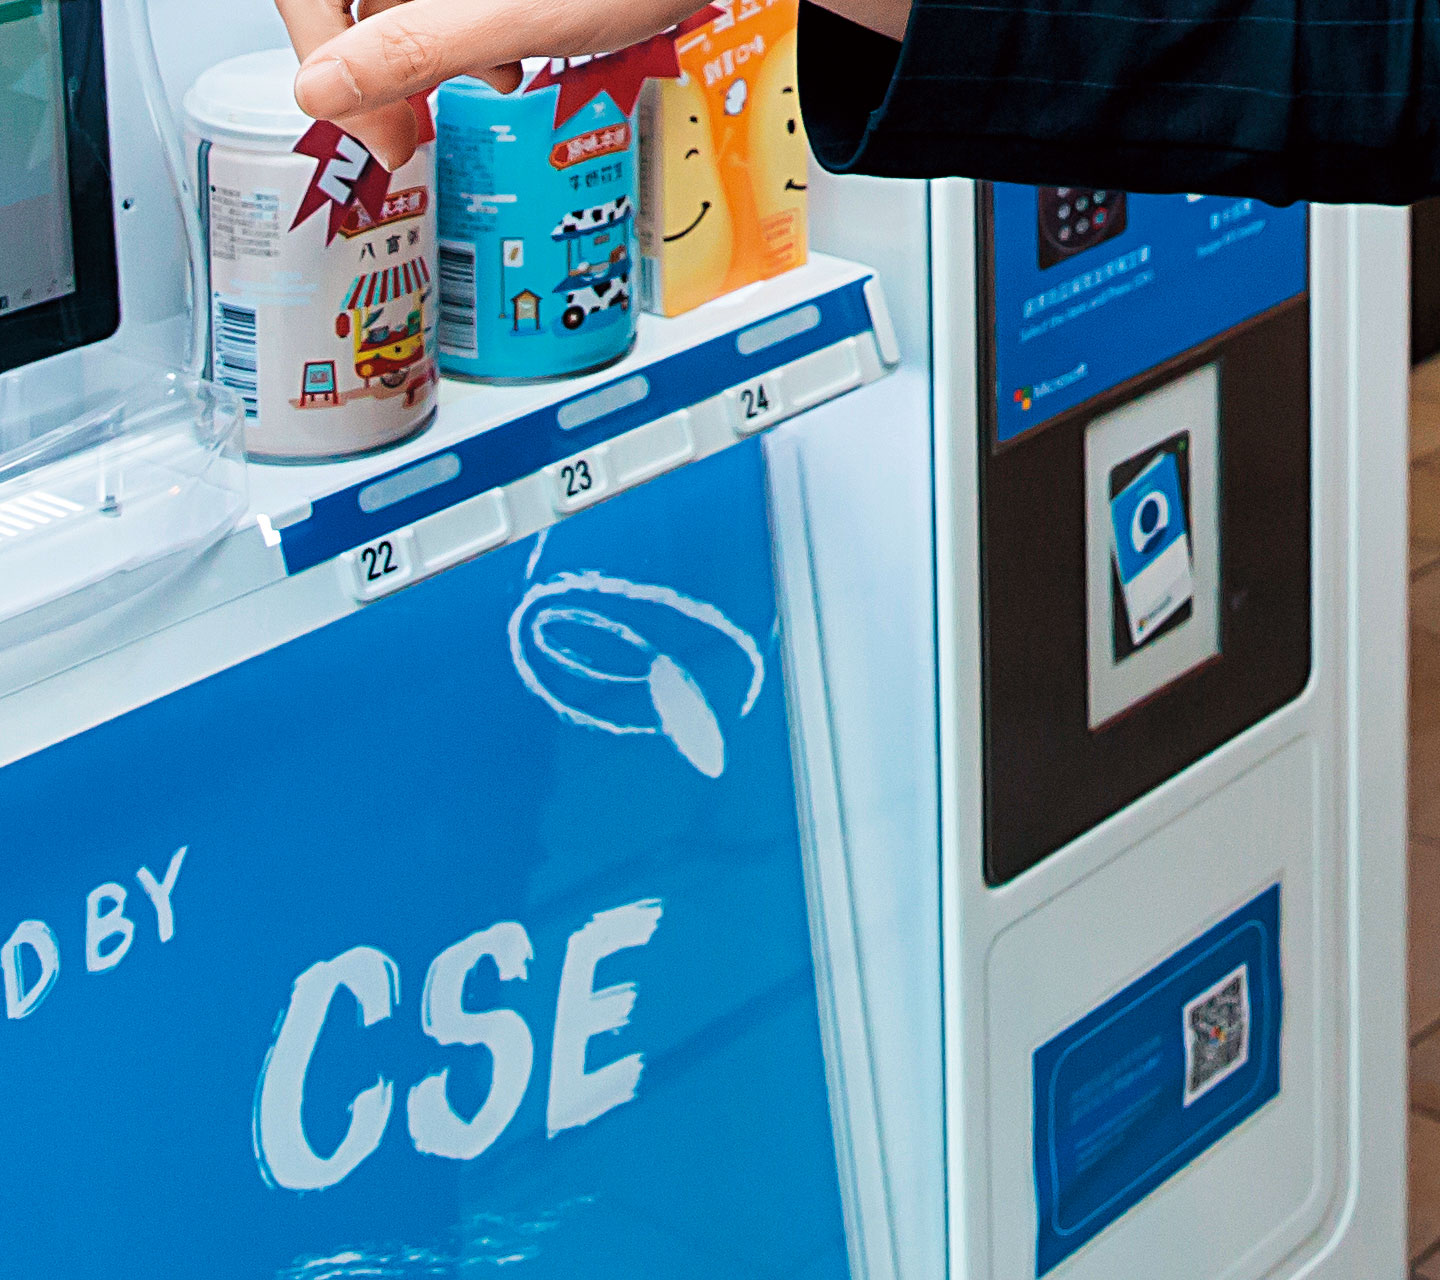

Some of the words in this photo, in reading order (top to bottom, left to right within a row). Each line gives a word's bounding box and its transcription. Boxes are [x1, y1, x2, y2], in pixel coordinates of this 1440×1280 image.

[740, 388, 771, 421] 24
[560, 460, 594, 498] 23
[361, 539, 399, 582] 22
[85, 844, 190, 975] BY
[251, 895, 669, 1194] CSE
